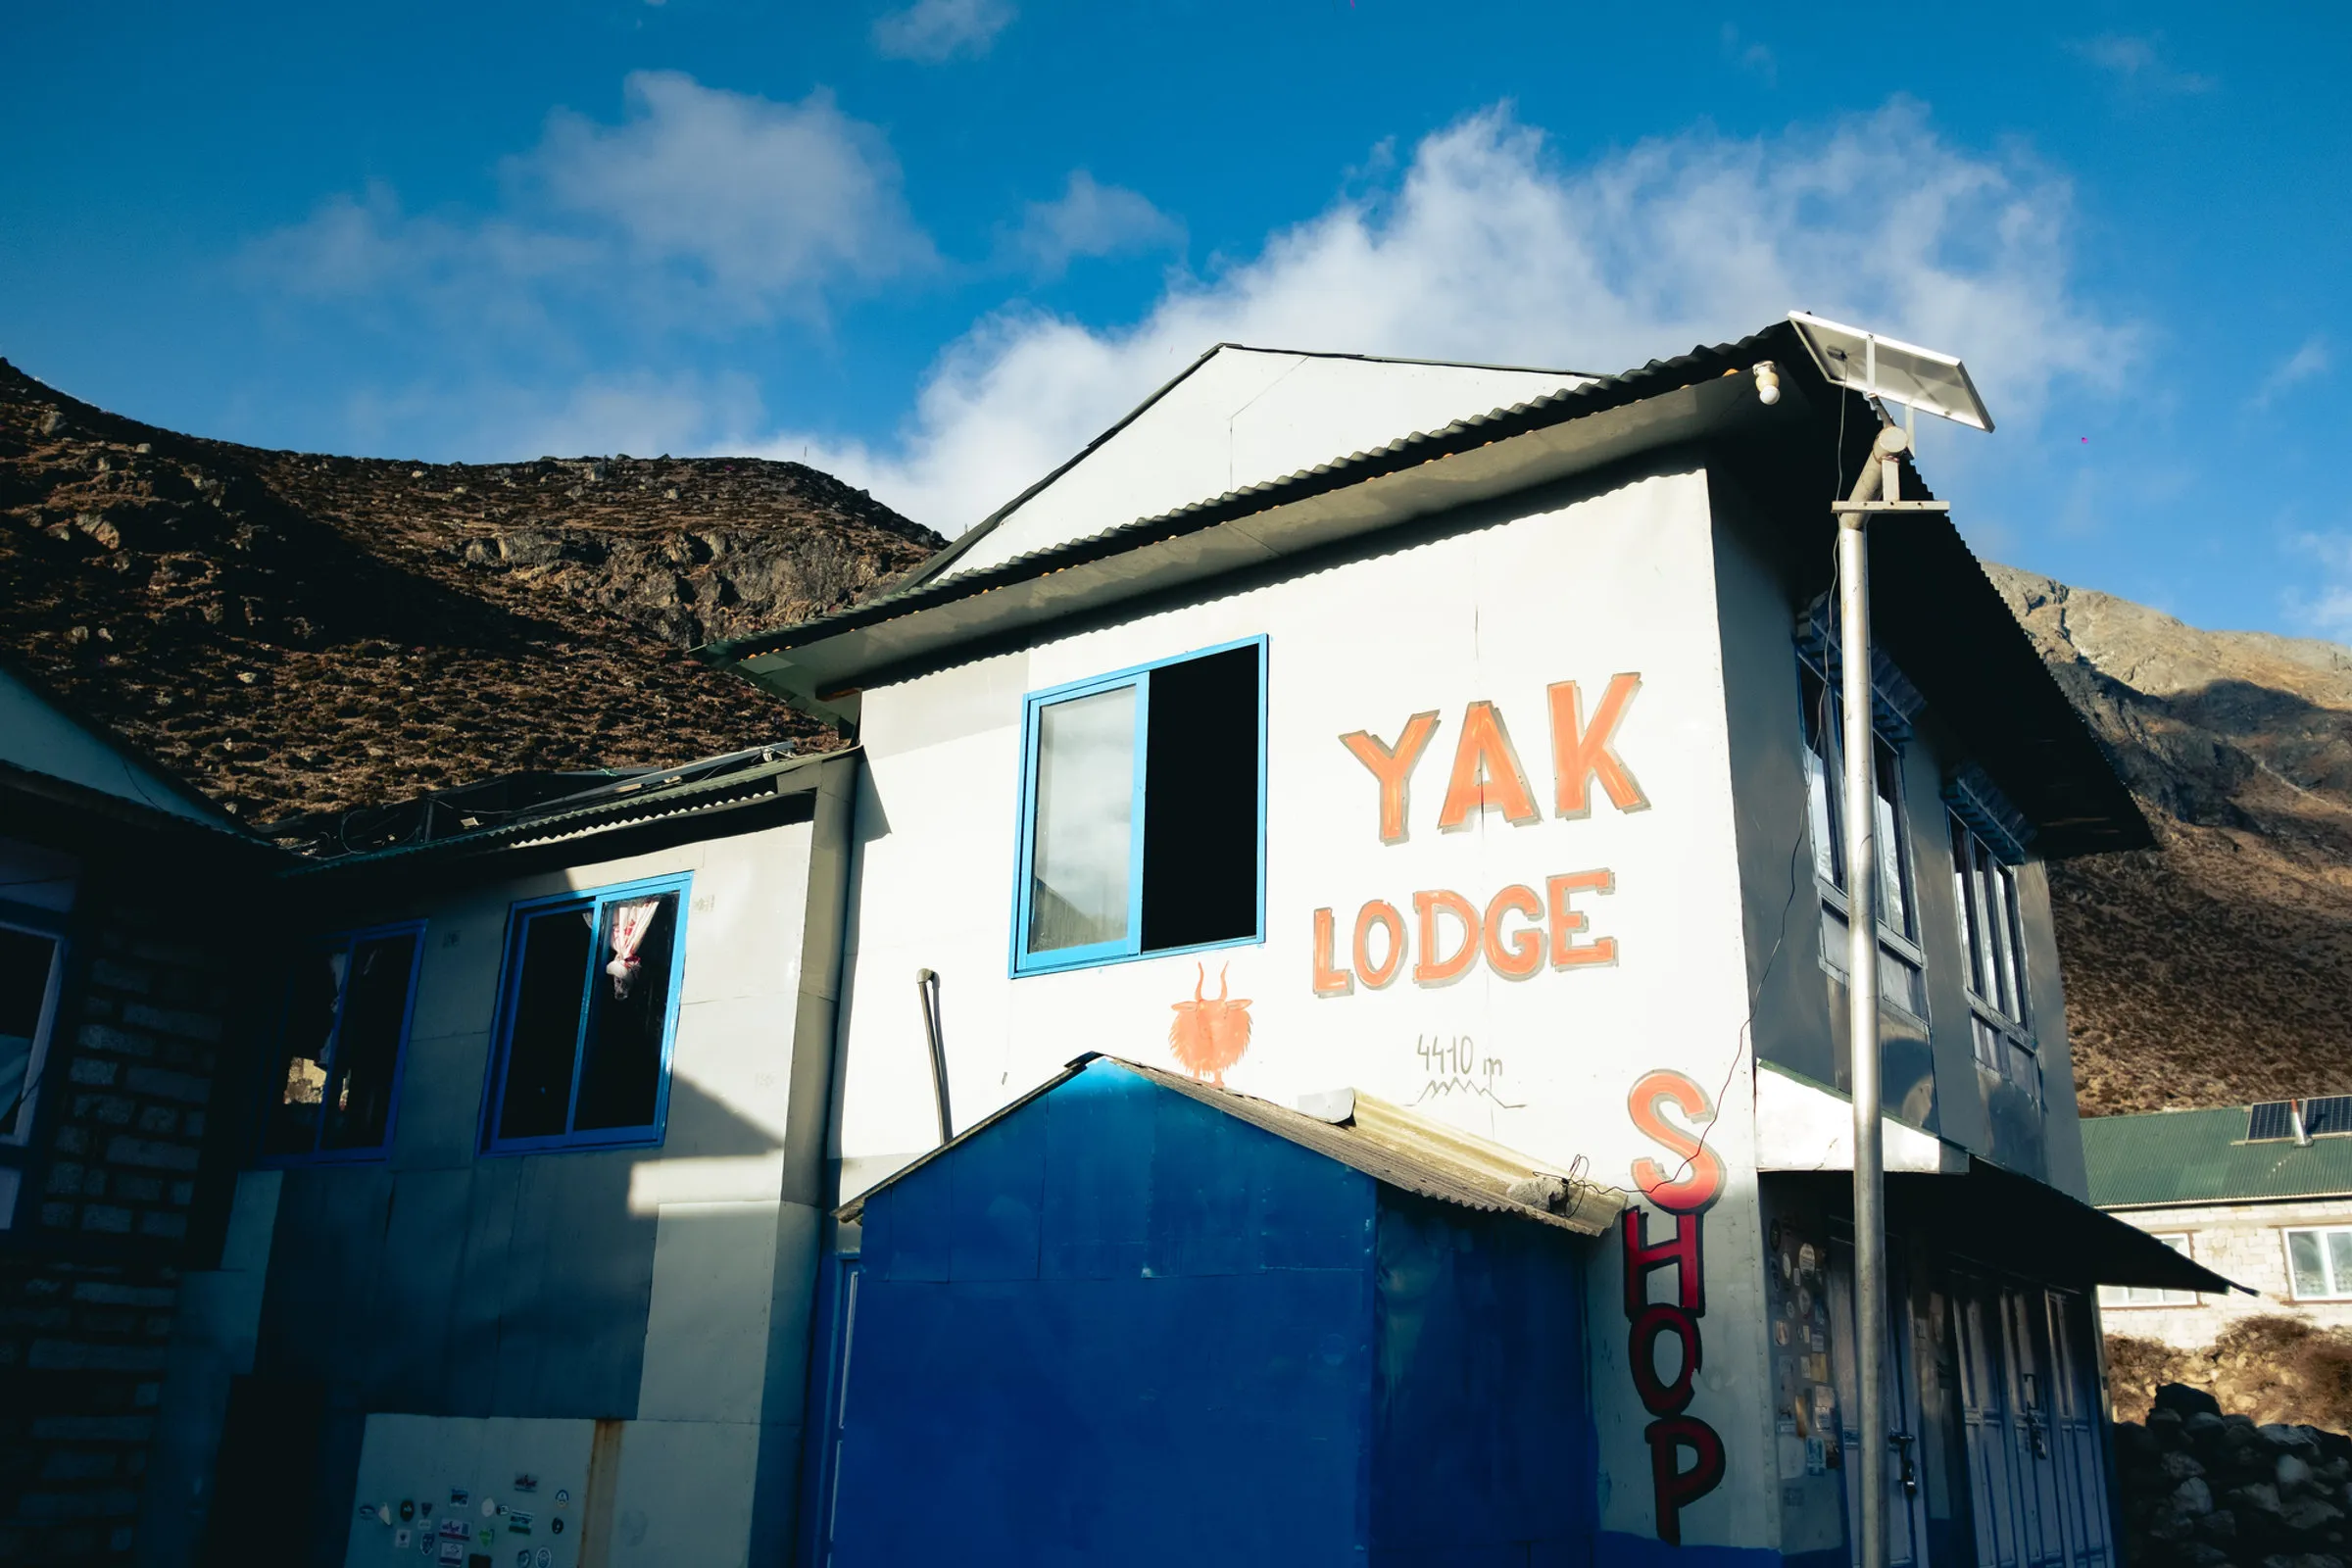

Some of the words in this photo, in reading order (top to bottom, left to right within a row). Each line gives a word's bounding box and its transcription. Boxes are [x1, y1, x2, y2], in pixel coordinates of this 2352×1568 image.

[1339, 672, 1651, 846] YAK
[1313, 867, 1618, 998] LODGE
[1417, 1034, 1473, 1075] 4410
[1483, 1057, 1502, 1076] m
[1622, 1069, 1727, 1546] SHOP
